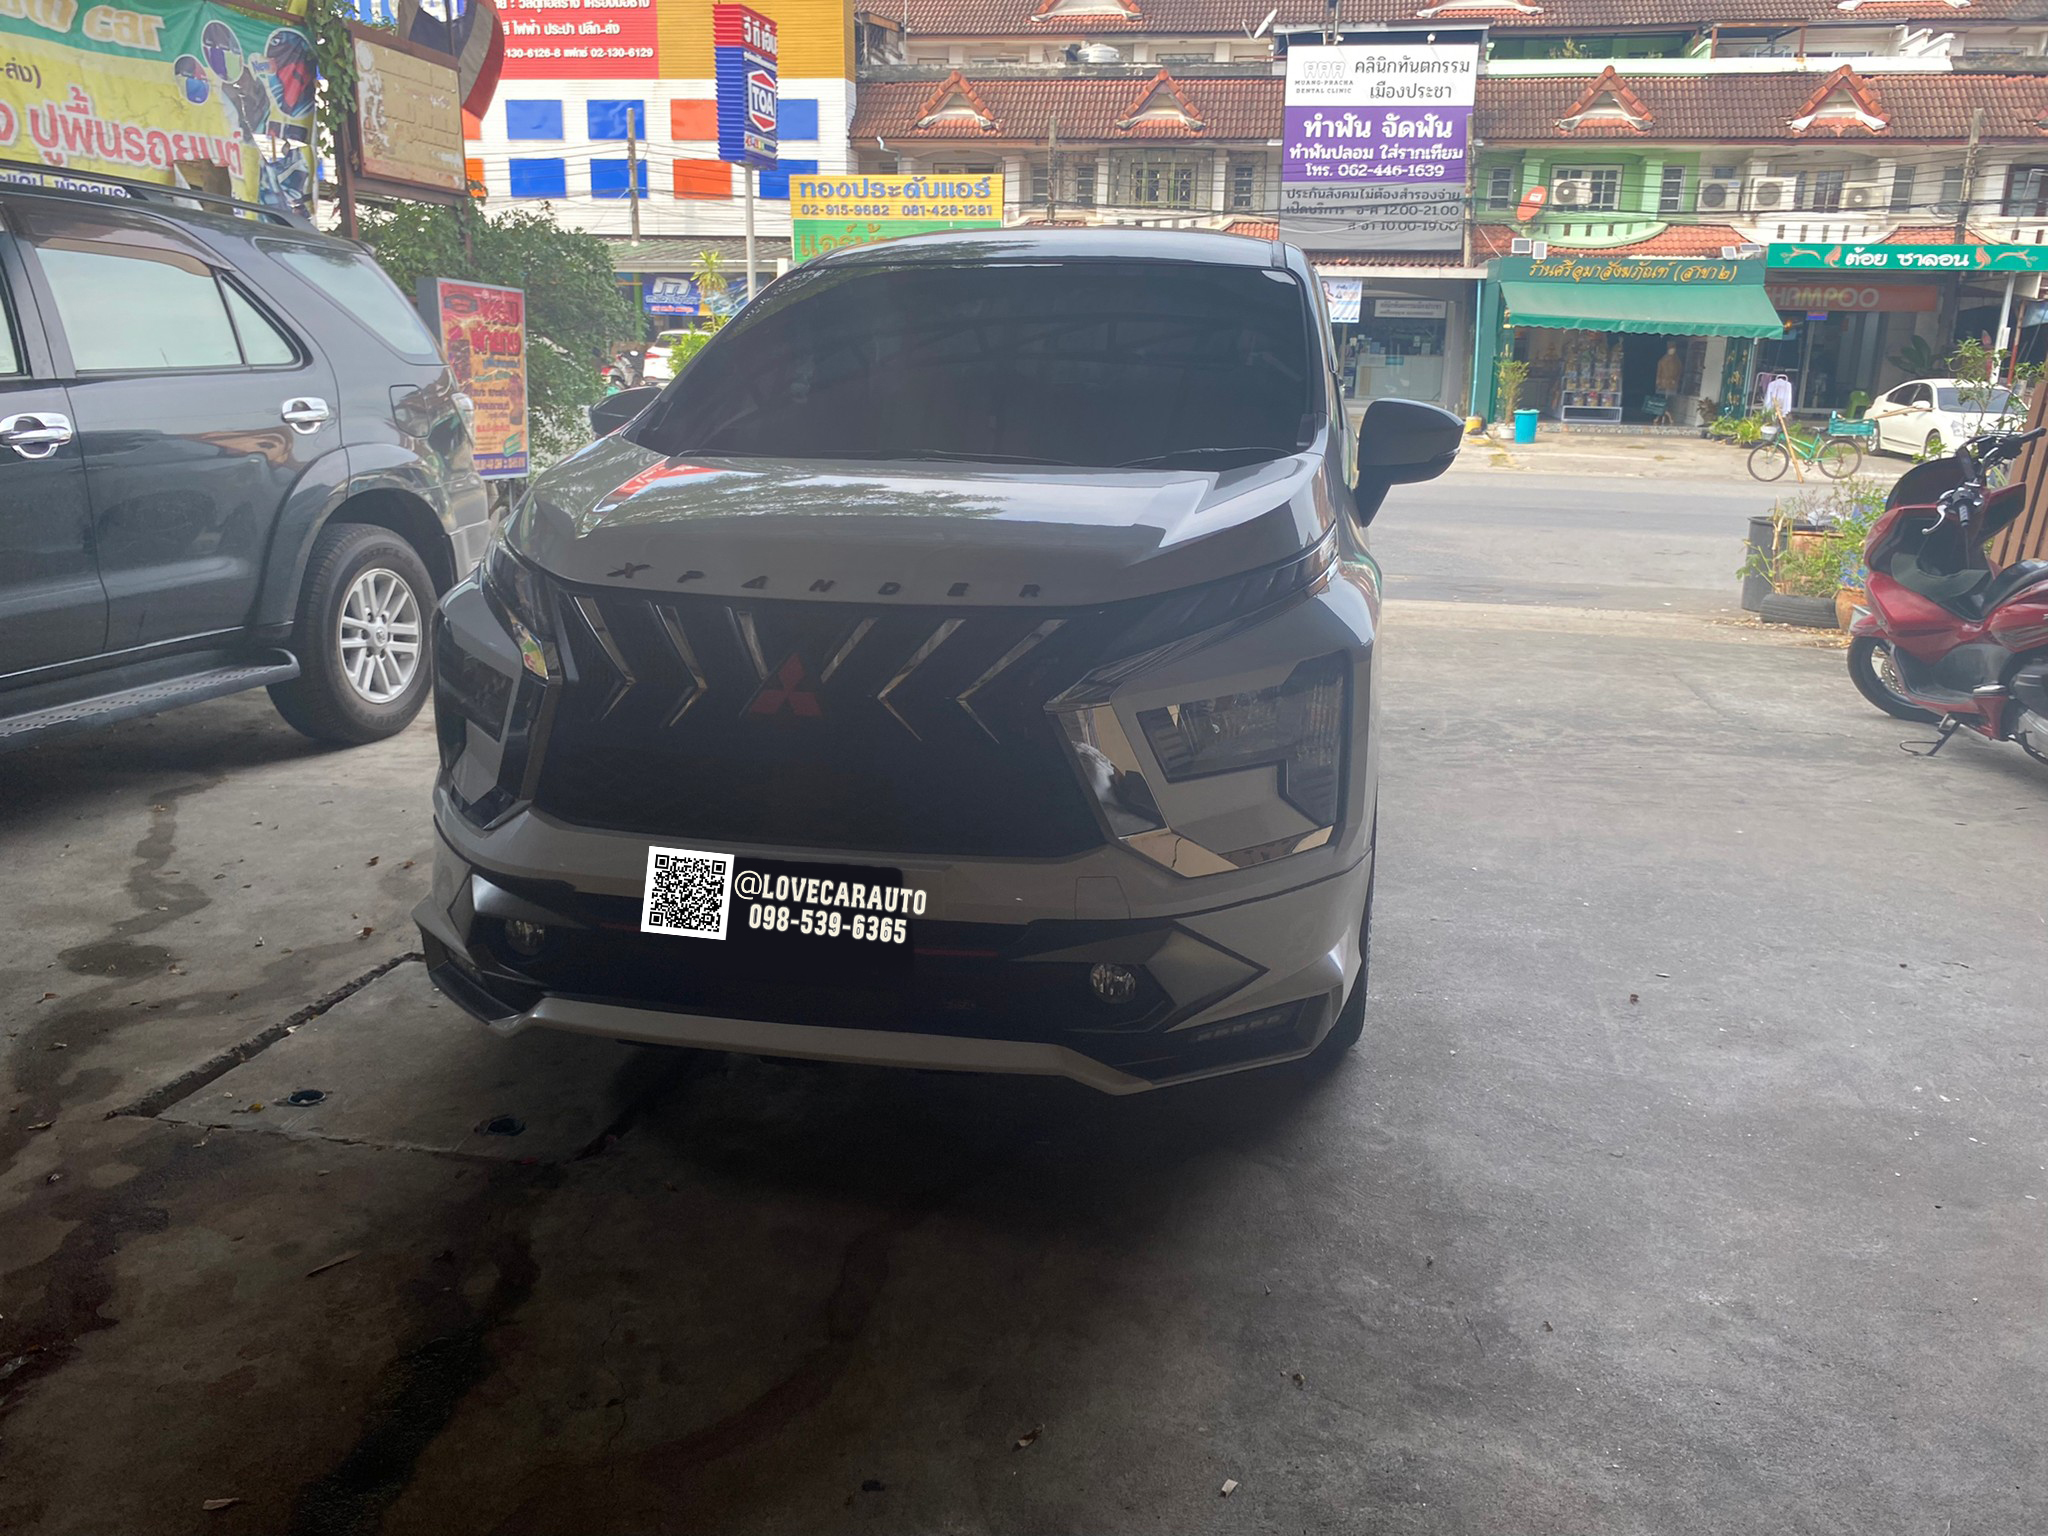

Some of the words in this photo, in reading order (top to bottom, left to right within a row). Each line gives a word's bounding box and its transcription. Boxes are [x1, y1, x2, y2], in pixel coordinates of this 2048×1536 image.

[84, 7, 164, 50] car
[513, 19, 541, 35] ไฟฟ้า
[544, 23, 575, 35] ประปา
[578, 20, 621, 35] ปลีก-ส่ง
[590, 48, 654, 58] 02-130-6129
[1354, 55, 1470, 74] คลินิกทันตกรรม
[1370, 80, 1452, 99] เมืองประชา
[752, 87, 774, 117] TOA
[29, 86, 243, 177] ปูพื้นรถยนต์
[1303, 112, 1372, 138] ทำฟัน
[1381, 112, 1453, 138] จัดฟัน
[1289, 143, 1374, 160] ทำฟันปลอม
[1379, 143, 1464, 160] ใส่รากเทียม
[1305, 163, 1334, 177] โทร.
[1337, 164, 1445, 177] 062-446-1639
[800, 176, 991, 199] ทองประดับแอร์
[1286, 187, 1460, 201] ประกันสังคมไม่ต้องสำรองจ่าย
[902, 204, 993, 217] 081-428-1281
[1383, 204, 1459, 216] 12.00-21.00
[1380, 220, 1458, 232] 10.00-19.00
[1845, 247, 1887, 266] ต้อย
[1897, 253, 1968, 267] ซาลอน
[606, 563, 1042, 598] XPANDER
